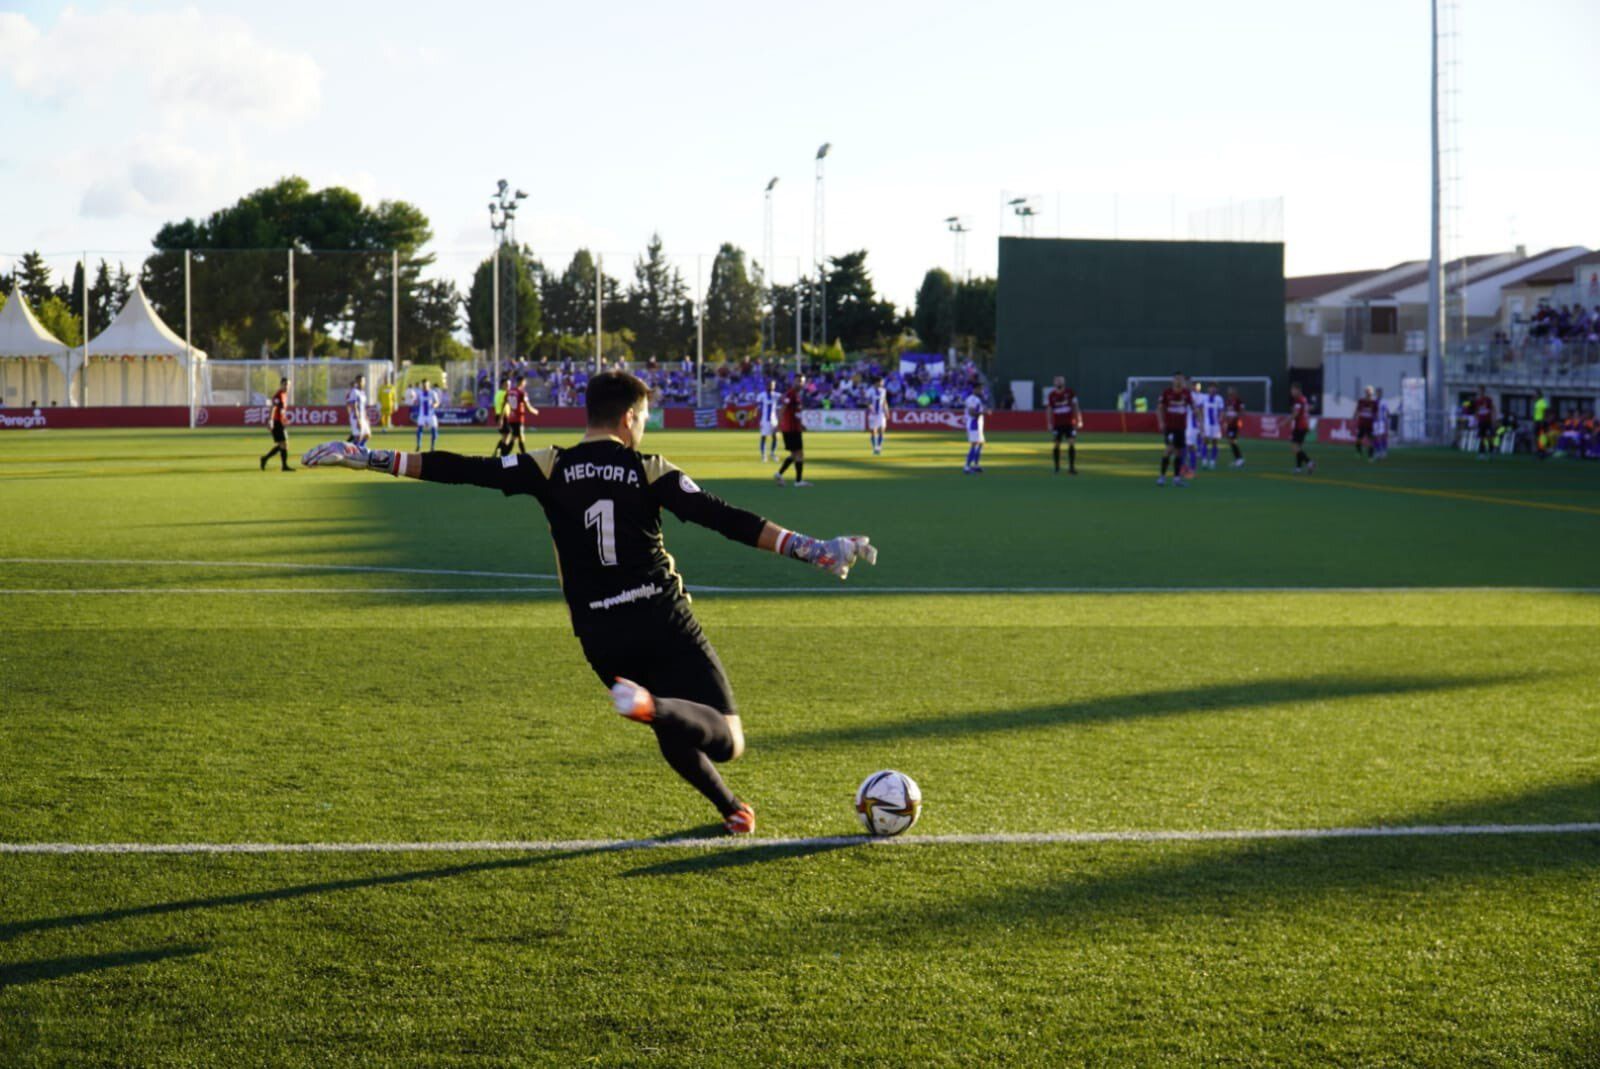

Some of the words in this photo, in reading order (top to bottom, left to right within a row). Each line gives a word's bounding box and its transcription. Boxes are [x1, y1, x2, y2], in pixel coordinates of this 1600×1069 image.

[261, 407, 338, 424] Fotters
[564, 462, 625, 484] HECTOR
[627, 469, 640, 488] P.
[584, 499, 617, 566] 1
